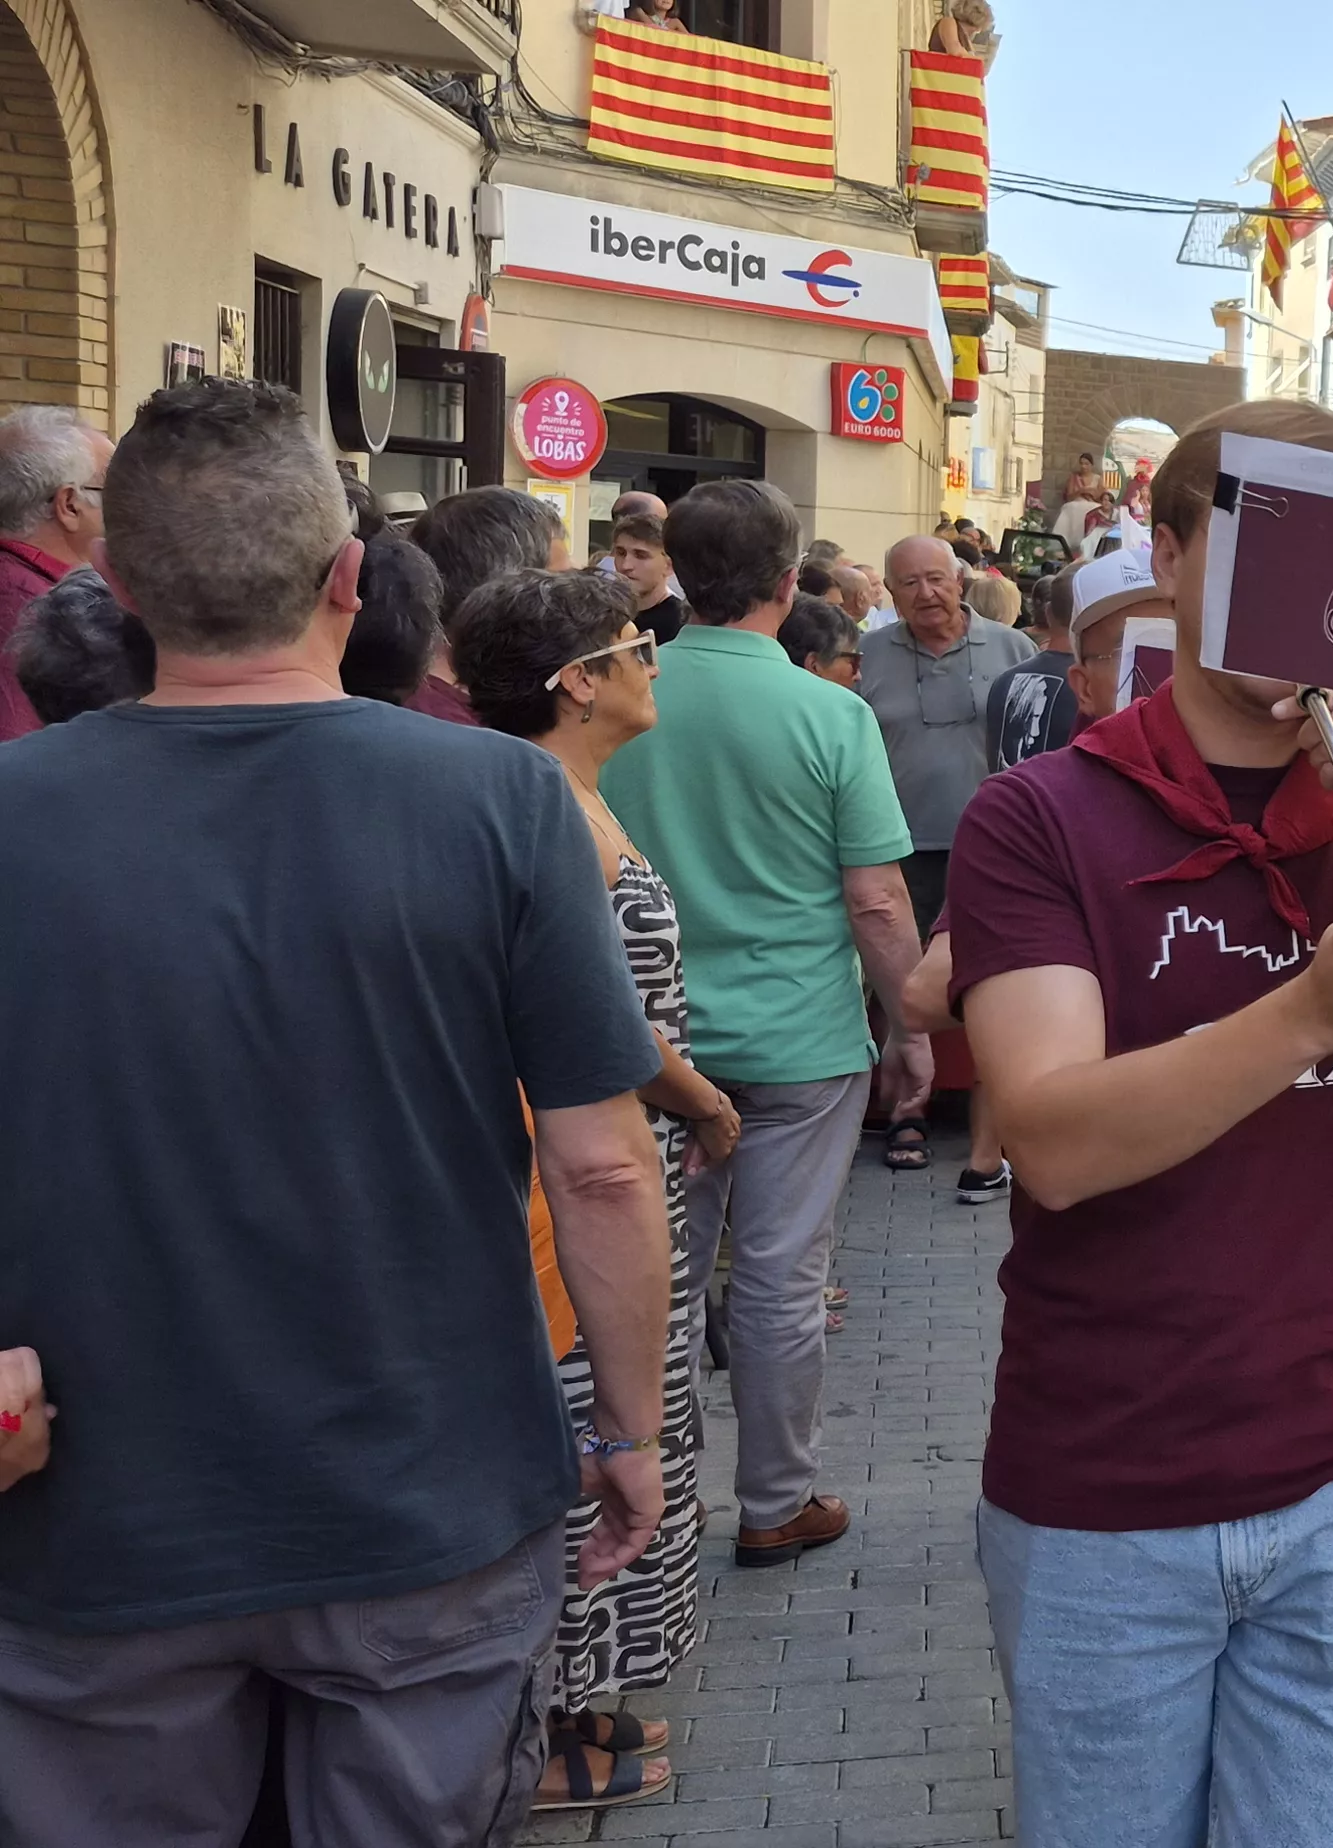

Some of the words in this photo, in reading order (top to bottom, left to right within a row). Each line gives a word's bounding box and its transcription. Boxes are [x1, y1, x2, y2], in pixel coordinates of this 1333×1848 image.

[253, 104, 304, 187] LA
[332, 148, 459, 257] GATERA
[590, 215, 766, 286] iberCaja
[537, 424, 585, 437] encuentro
[541, 415, 569, 425] punto
[570, 418, 582, 427] de
[844, 422, 872, 435] EURO
[873, 425, 901, 439] 6000
[534, 436, 587, 462] LOBAS
